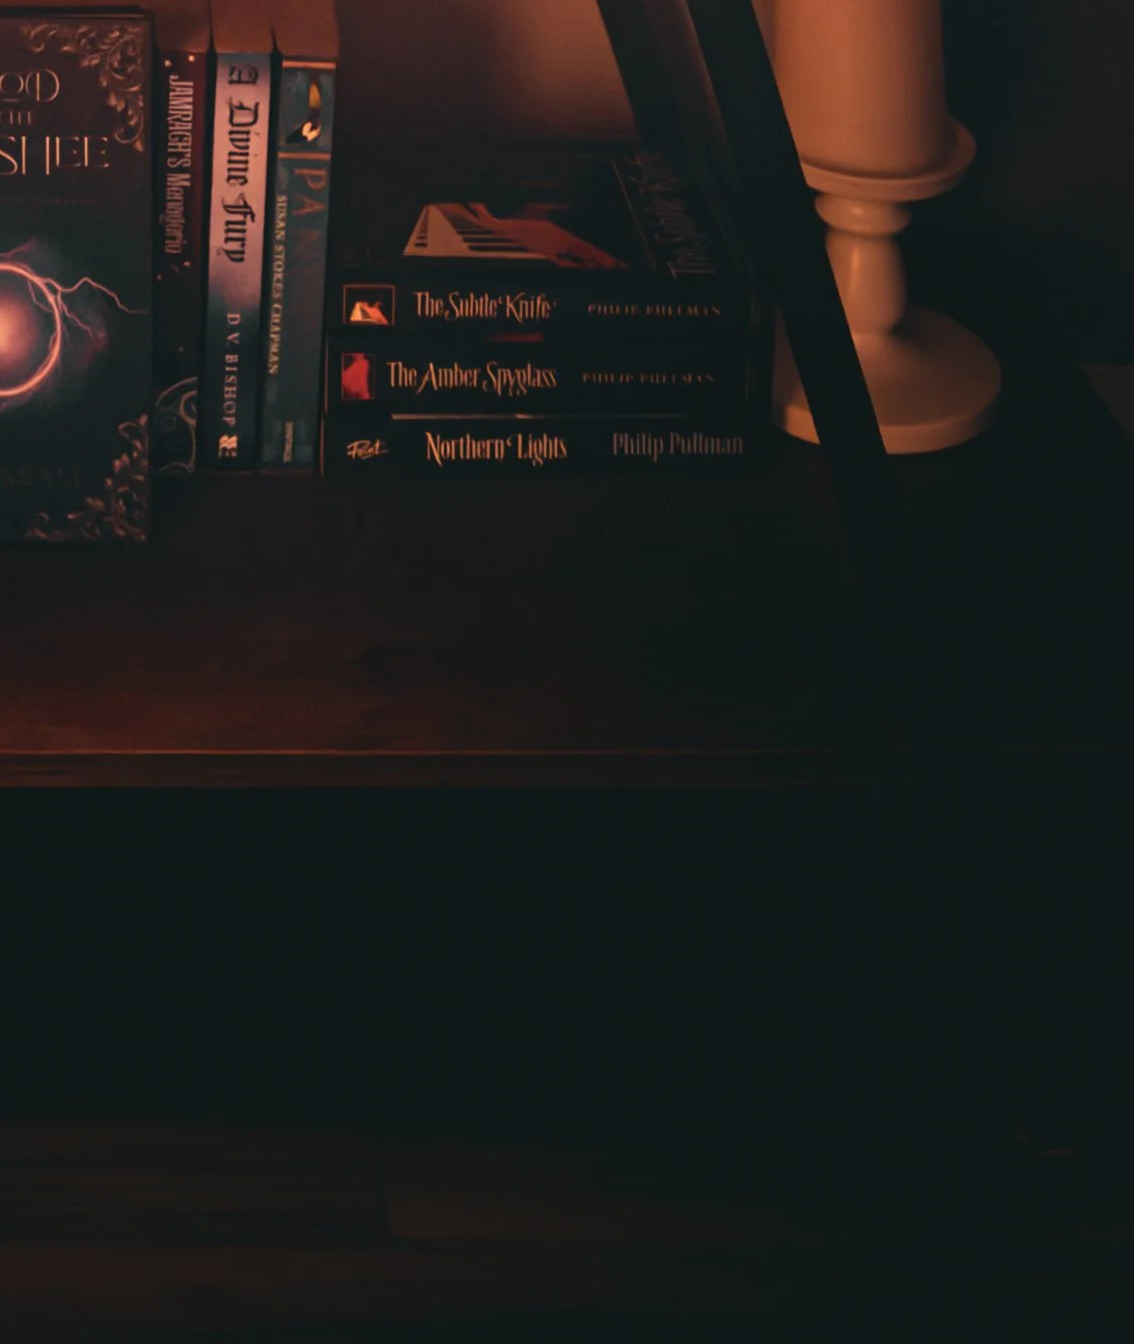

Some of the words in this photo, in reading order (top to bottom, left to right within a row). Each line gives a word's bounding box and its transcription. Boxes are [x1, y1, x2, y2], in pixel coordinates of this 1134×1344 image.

[229, 65, 258, 86] A
[166, 74, 194, 168] JAMRACH'S
[223, 98, 259, 187] Divine
[215, 192, 256, 263] Fury
[274, 194, 288, 241] SUSAN
[271, 244, 287, 299] STOKES
[412, 289, 444, 319] The
[443, 290, 503, 323] Subtle
[506, 291, 552, 325] Knife
[586, 303, 637, 316] PHILIP
[268, 303, 284, 375] CHAPMAN
[222, 353, 240, 428] BISHOP
[386, 361, 418, 387] The
[414, 361, 480, 395] Amber
[481, 361, 558, 396] Spyglass
[582, 371, 634, 385] PHILIP
[425, 431, 505, 467] Northern
[517, 432, 569, 467] Lights
[611, 432, 664, 463] Philip
[669, 431, 744, 456] Pullman
